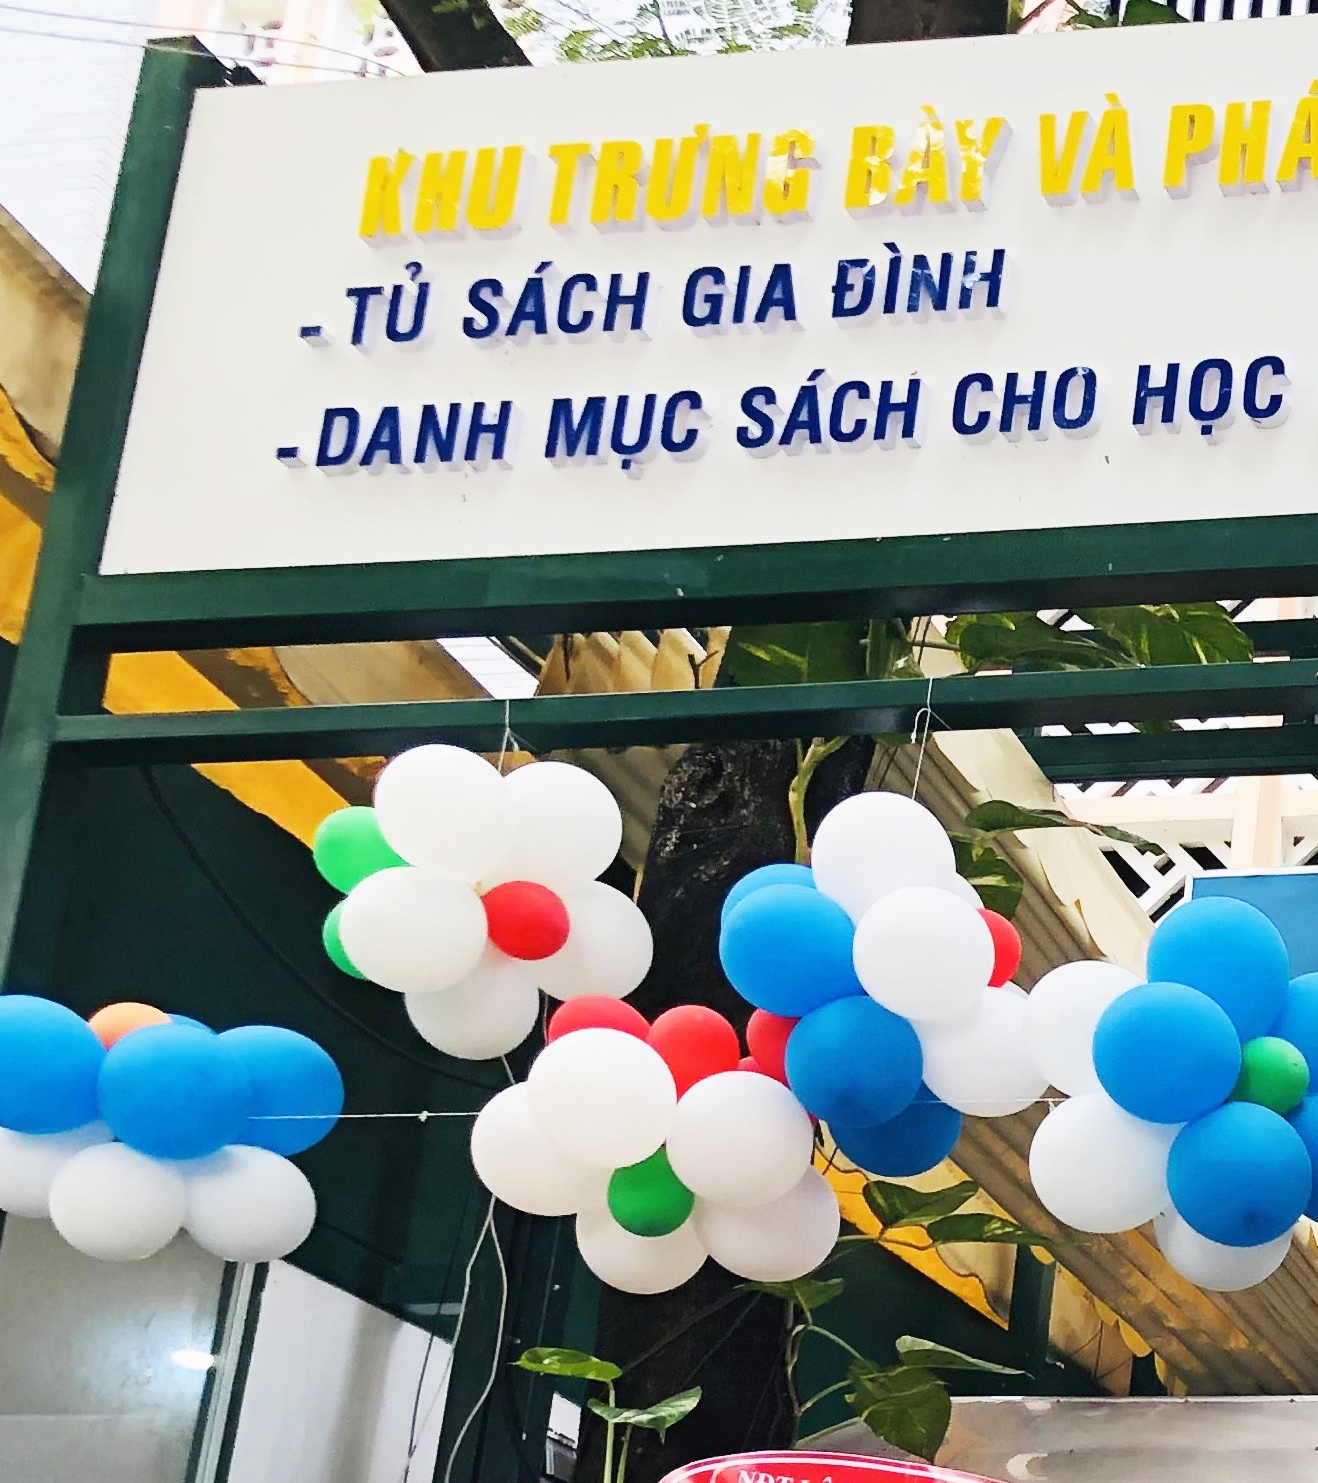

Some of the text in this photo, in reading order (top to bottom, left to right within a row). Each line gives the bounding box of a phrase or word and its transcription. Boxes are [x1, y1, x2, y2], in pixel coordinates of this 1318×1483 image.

[360, 146, 524, 239] KHU
[549, 124, 815, 225] TRƯNG
[844, 105, 1005, 209] BÀY
[1039, 92, 1136, 196] VÀ
[346, 261, 430, 344] TỦ
[463, 261, 649, 339] SÁCH
[683, 264, 797, 327] GIA
[832, 242, 1005, 318] ĐÌNH
[545, 390, 701, 470] MỤC
[736, 369, 920, 449] SÁCH
[952, 365, 1098, 437] CHO
[1132, 356, 1284, 437] HỌC
